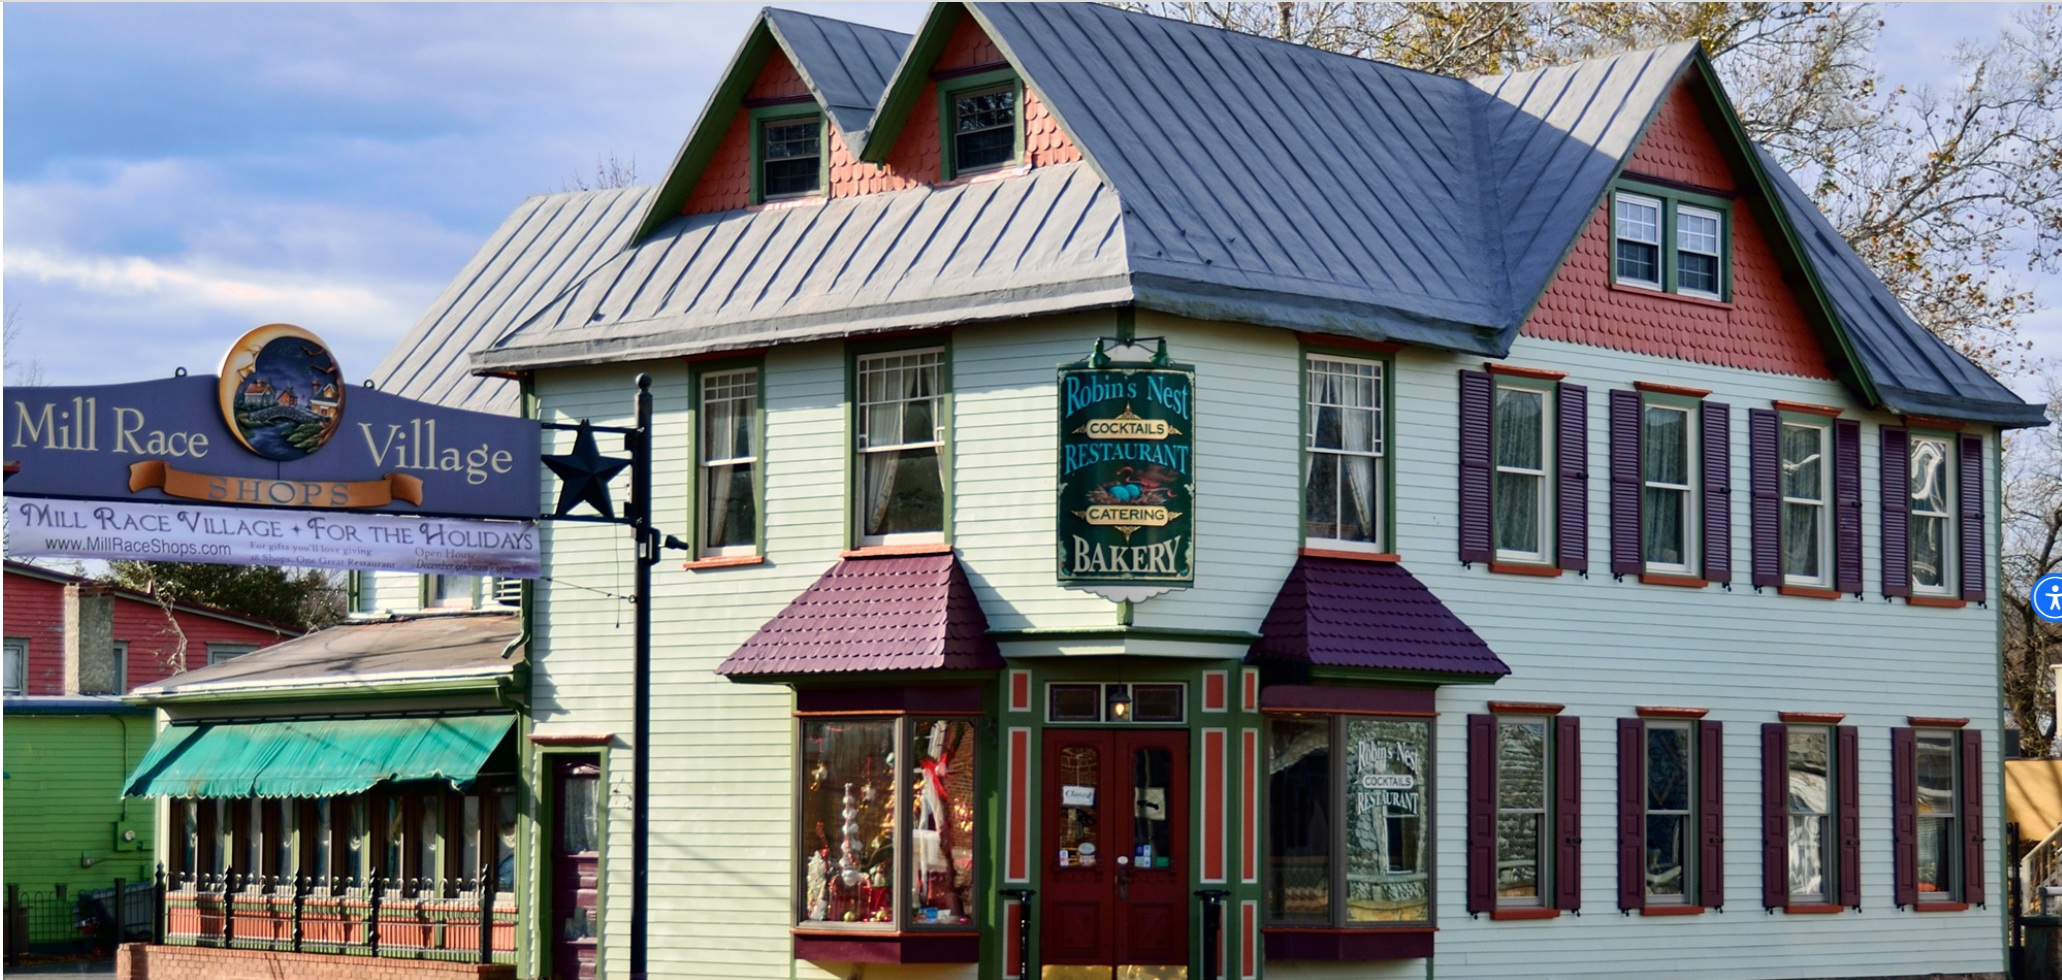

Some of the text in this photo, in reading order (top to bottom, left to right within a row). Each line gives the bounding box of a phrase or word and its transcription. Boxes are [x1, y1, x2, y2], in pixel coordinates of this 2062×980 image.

[1065, 375, 1189, 420] Robin's Nest
[1090, 422, 1165, 435] COCKTAILS
[11, 396, 513, 485] Mill Race Village
[1064, 443, 1188, 475] RESTAURANT
[208, 477, 349, 507] SHOPS
[1089, 508, 1164, 520] CATERING
[368, 526, 414, 545] THE
[45, 536, 231, 557] www.MillRaceShops.com
[250, 541, 372, 556] For gifts you'll love giving
[414, 547, 476, 560] Open House
[1072, 534, 1181, 573] BAKERY
[319, 557, 344, 565] Great
[348, 558, 396, 569] Restaurant
[416, 559, 454, 570] December
[1358, 741, 1418, 775] Robin's Nest
[1365, 777, 1411, 786] COCKTAILS
[1358, 792, 1418, 815] RESTAURANT
